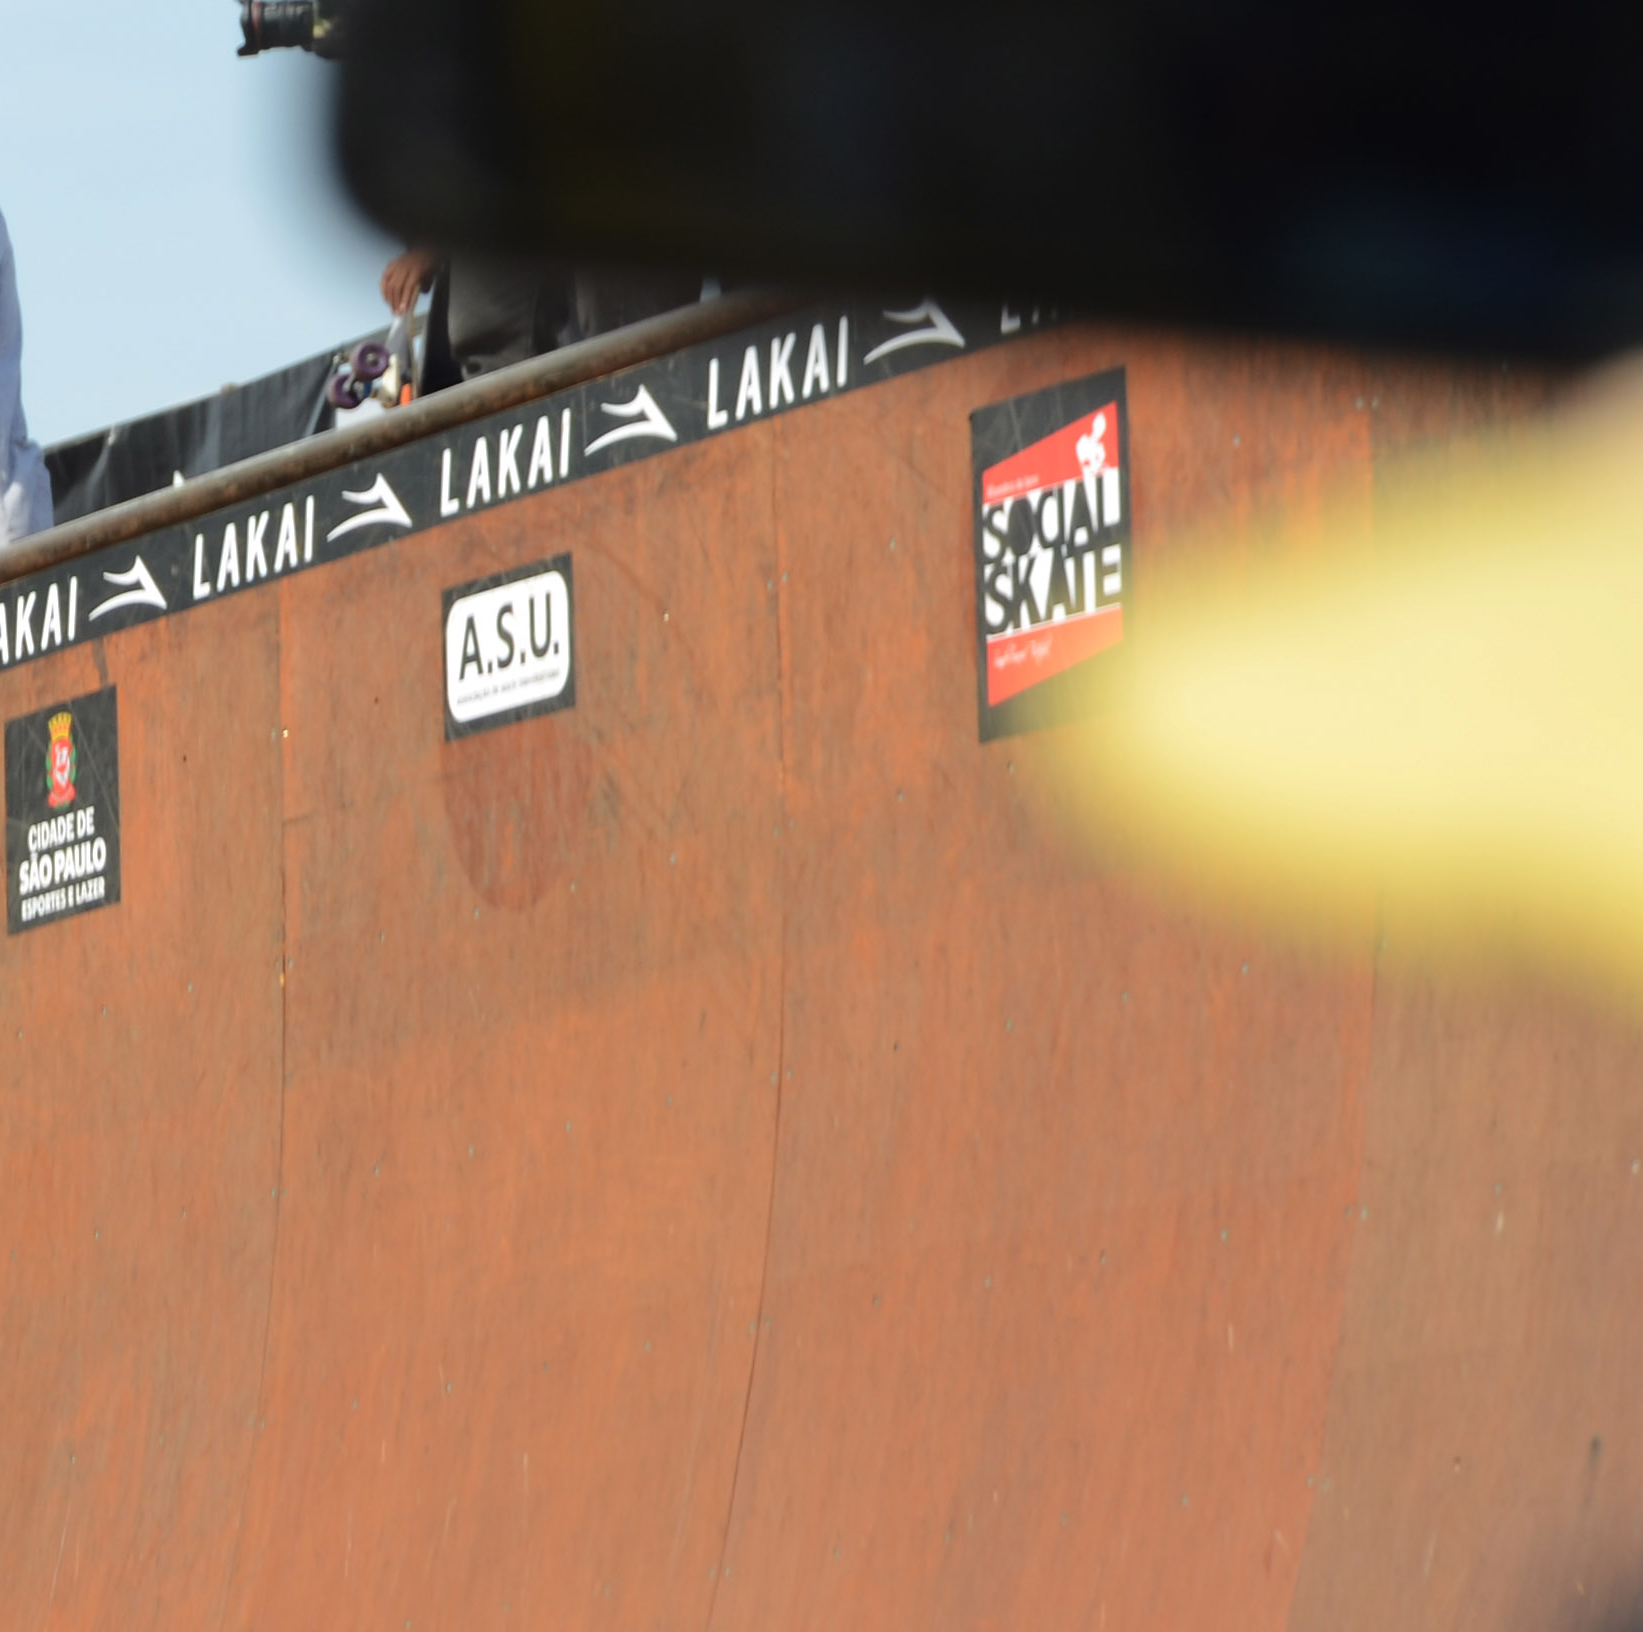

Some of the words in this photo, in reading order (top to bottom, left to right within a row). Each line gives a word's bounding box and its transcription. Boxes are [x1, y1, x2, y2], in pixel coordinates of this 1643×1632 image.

[707, 318, 849, 430] LAKAI
[440, 408, 572, 517] LAKAI
[192, 495, 315, 600] LAKAI
[983, 472, 1121, 565] SOCIAL
[986, 541, 1123, 635] SKATE
[458, 591, 560, 682] A.S.U.
[19, 852, 53, 896] SÃO
[54, 837, 106, 884] PAULO
[28, 811, 75, 853] CIDADE
[76, 805, 95, 839] DE
[21, 886, 66, 922] ESPORTES
[67, 884, 75, 909] E
[75, 875, 106, 906] LAZER
